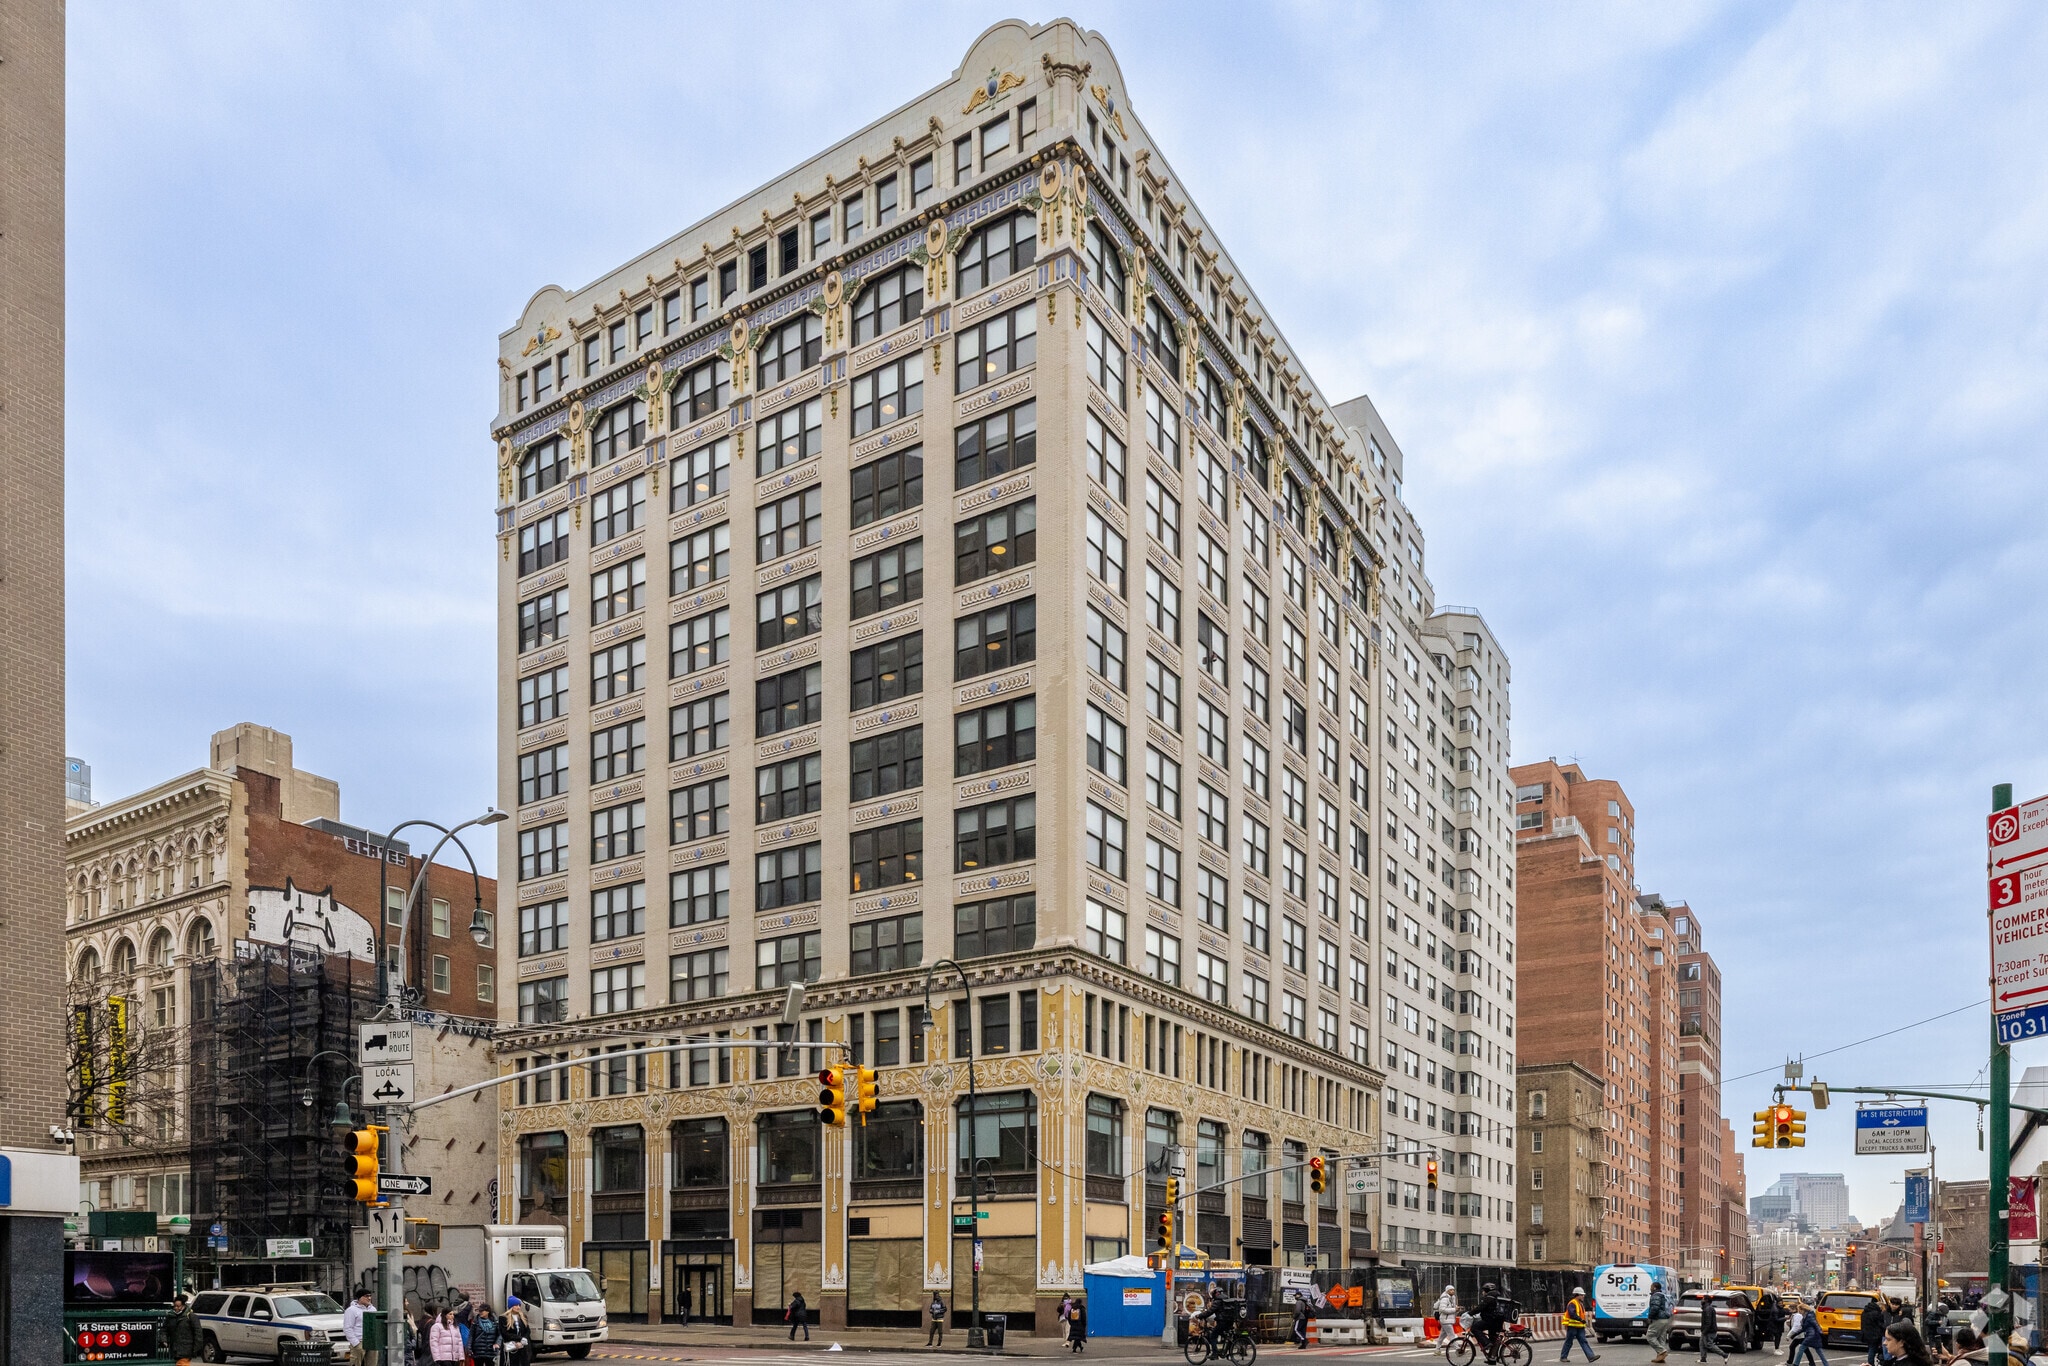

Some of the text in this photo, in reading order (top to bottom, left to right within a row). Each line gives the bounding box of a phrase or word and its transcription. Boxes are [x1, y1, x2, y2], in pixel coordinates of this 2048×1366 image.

[2023, 808, 2039, 820] 7am
[2024, 869, 2042, 881] hour
[1997, 958, 2030, 973] 7:30am
[1997, 971, 2029, 986] Except
[389, 1030, 410, 1039] TRUCK
[389, 1043, 410, 1053] ROUTE
[375, 1068, 401, 1077] LOCAL
[1861, 1111, 1868, 1119] 14
[1879, 1109, 1924, 1118] RESTRICTION
[1893, 1129, 1911, 1137] 10PM
[385, 1179, 423, 1189] ONE WAY
[370, 1235, 402, 1244] ONLY ONLY
[1607, 1273, 1638, 1287] Spot
[78, 1322, 152, 1332] 14 Street Station
[83, 1334, 127, 1344] 1 2 3
